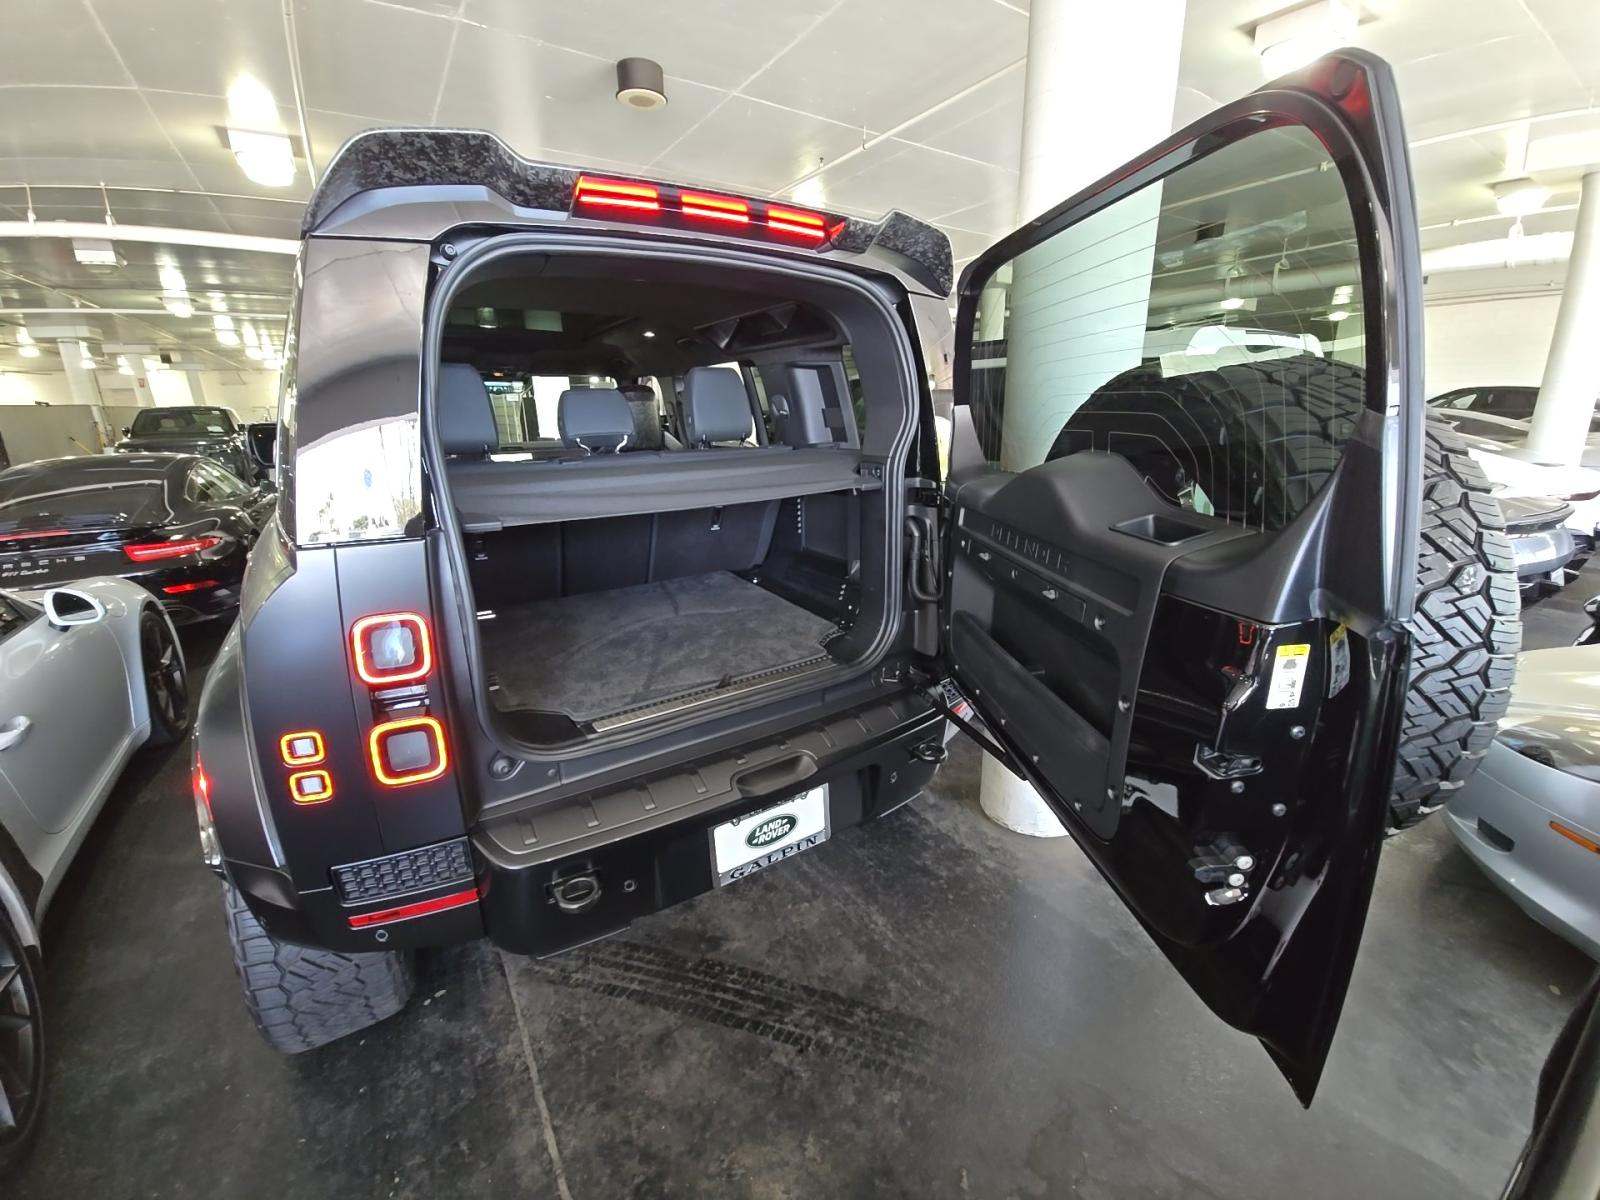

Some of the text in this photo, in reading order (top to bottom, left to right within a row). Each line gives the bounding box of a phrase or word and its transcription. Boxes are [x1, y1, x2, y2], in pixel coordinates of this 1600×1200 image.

[755, 817, 782, 836] LAND
[757, 824, 791, 845] ROVER
[729, 835, 818, 879] GALPIN
